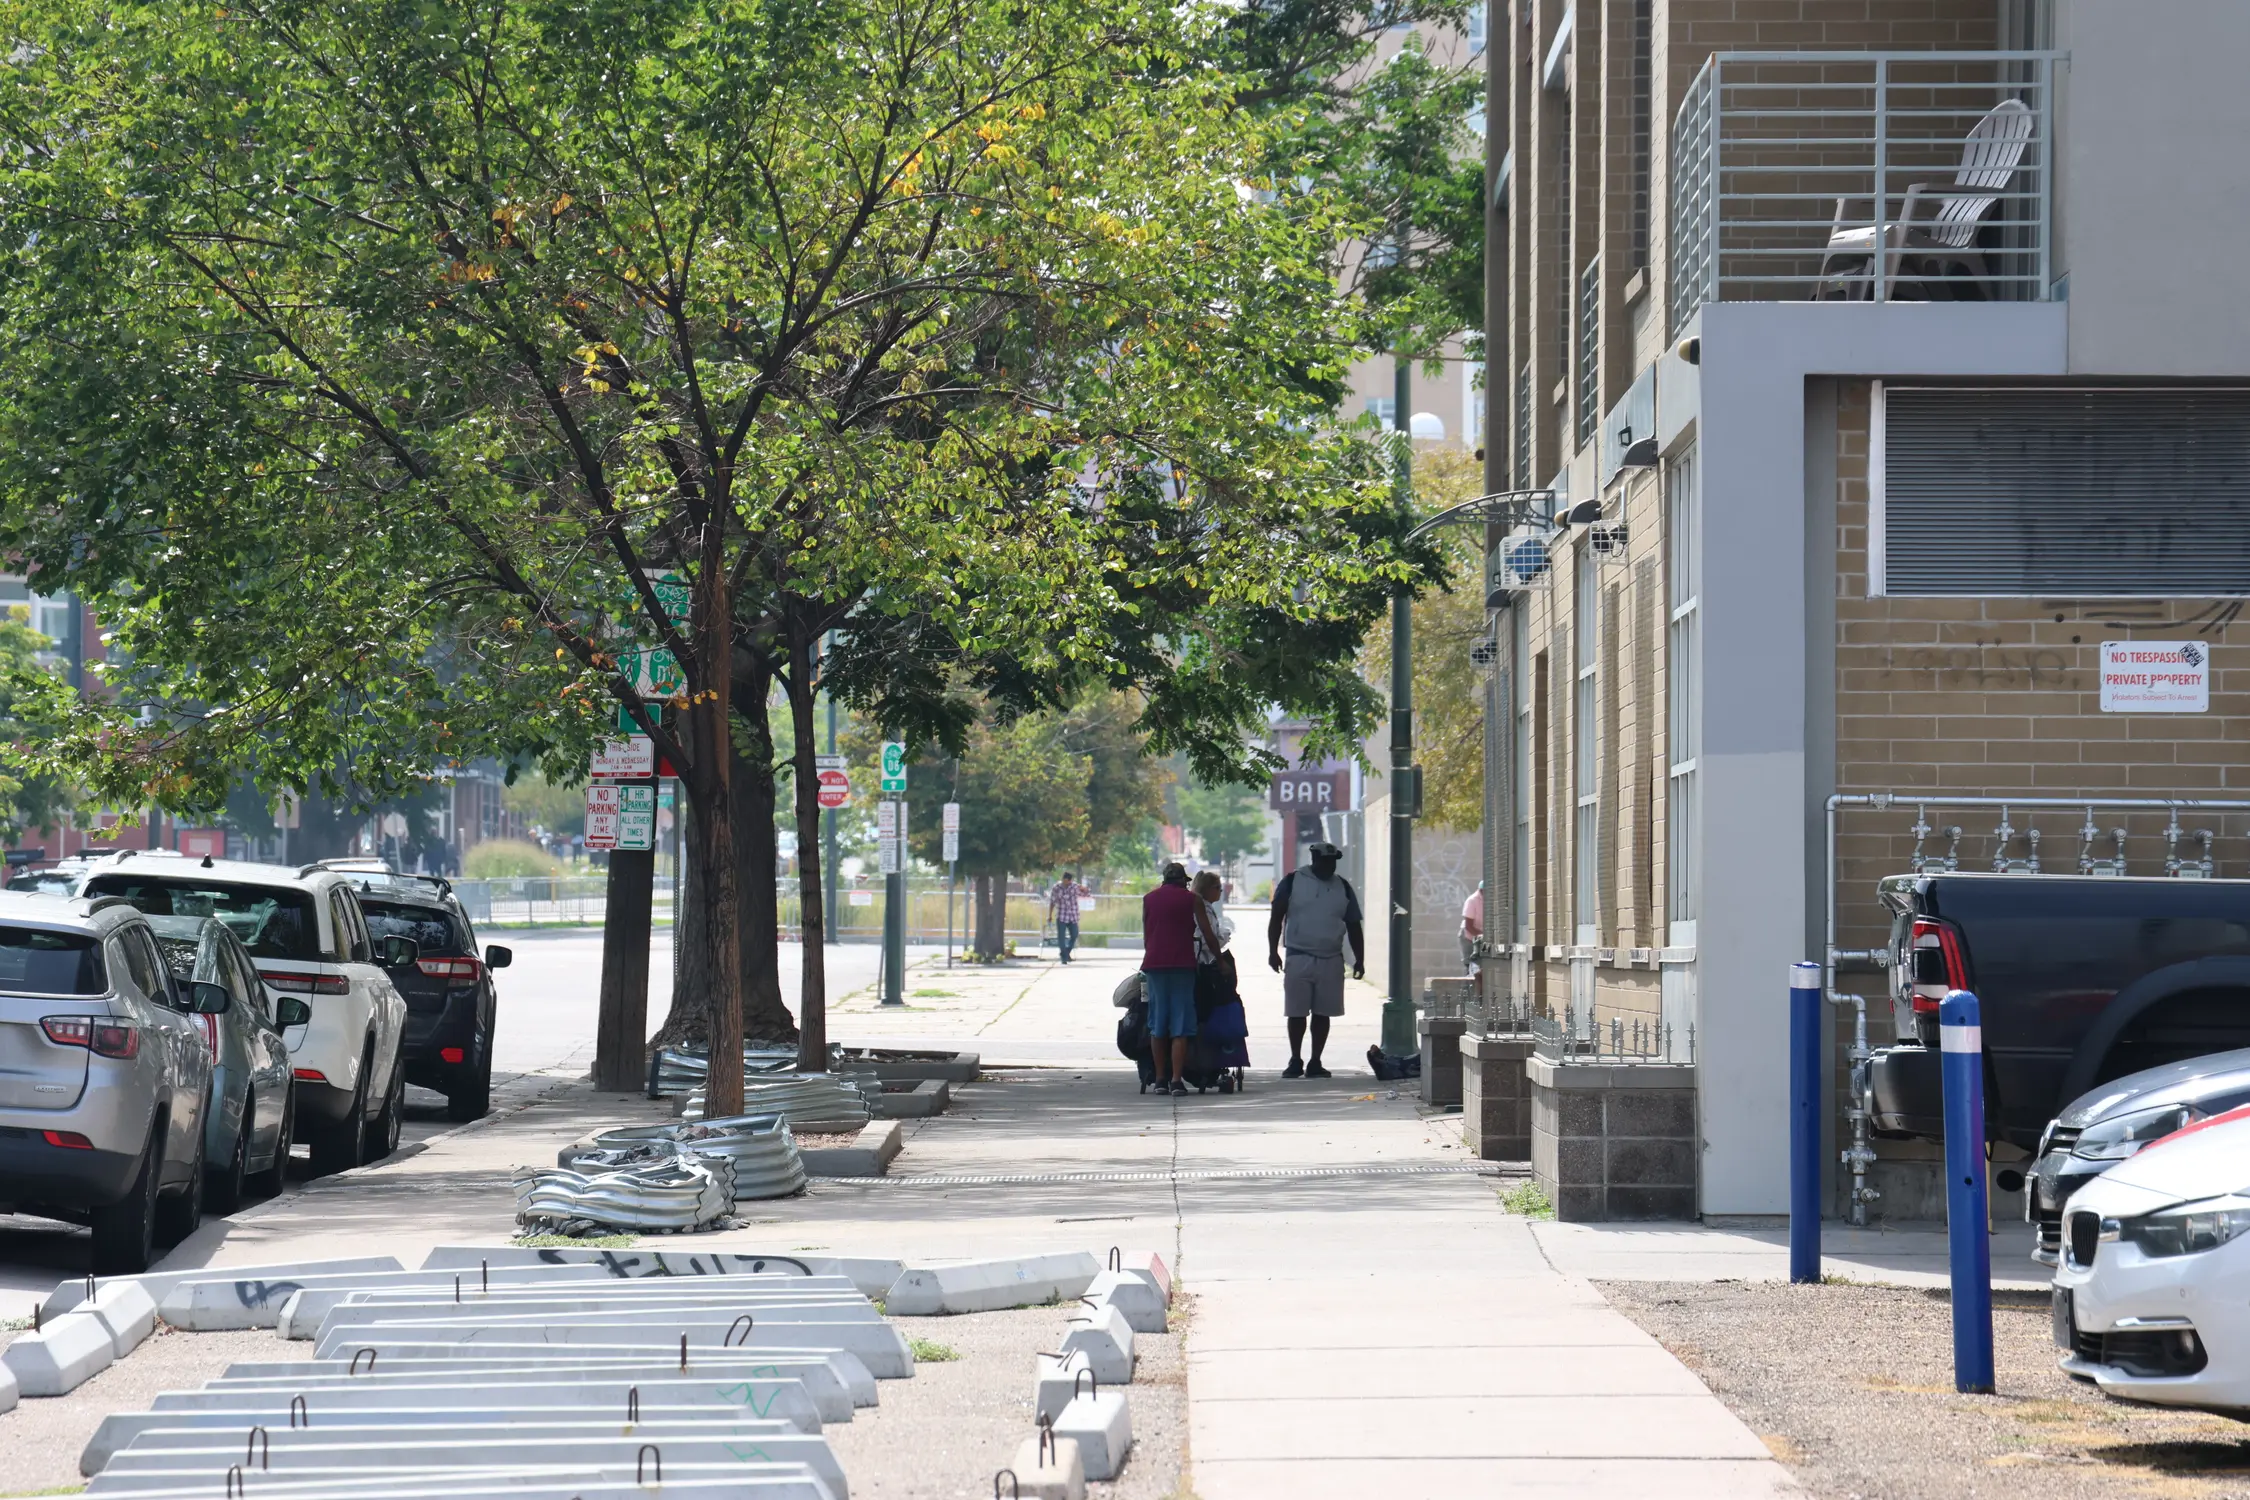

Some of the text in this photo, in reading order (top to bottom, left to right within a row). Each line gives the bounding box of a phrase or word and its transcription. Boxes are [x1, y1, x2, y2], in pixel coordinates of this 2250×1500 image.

[2111, 652, 2188, 663] NO TRESPASSIN
[2106, 674, 2147, 685] PRIVATE
[2112, 693, 2140, 702] Violators
[2142, 693, 2166, 702] Subject
[609, 743, 640, 752] THIS SIDE
[596, 757, 615, 765] MONDAY
[597, 790, 608, 801] NO
[635, 790, 644, 799] HR
[1280, 781, 1332, 803] BAR
[588, 803, 617, 815] PARKING
[628, 800, 651, 810] PARKING
[595, 816, 609, 824] ANY
[622, 816, 631, 824] ALL
[594, 826, 609, 834] TIME
[627, 828, 643, 836] TIMES
